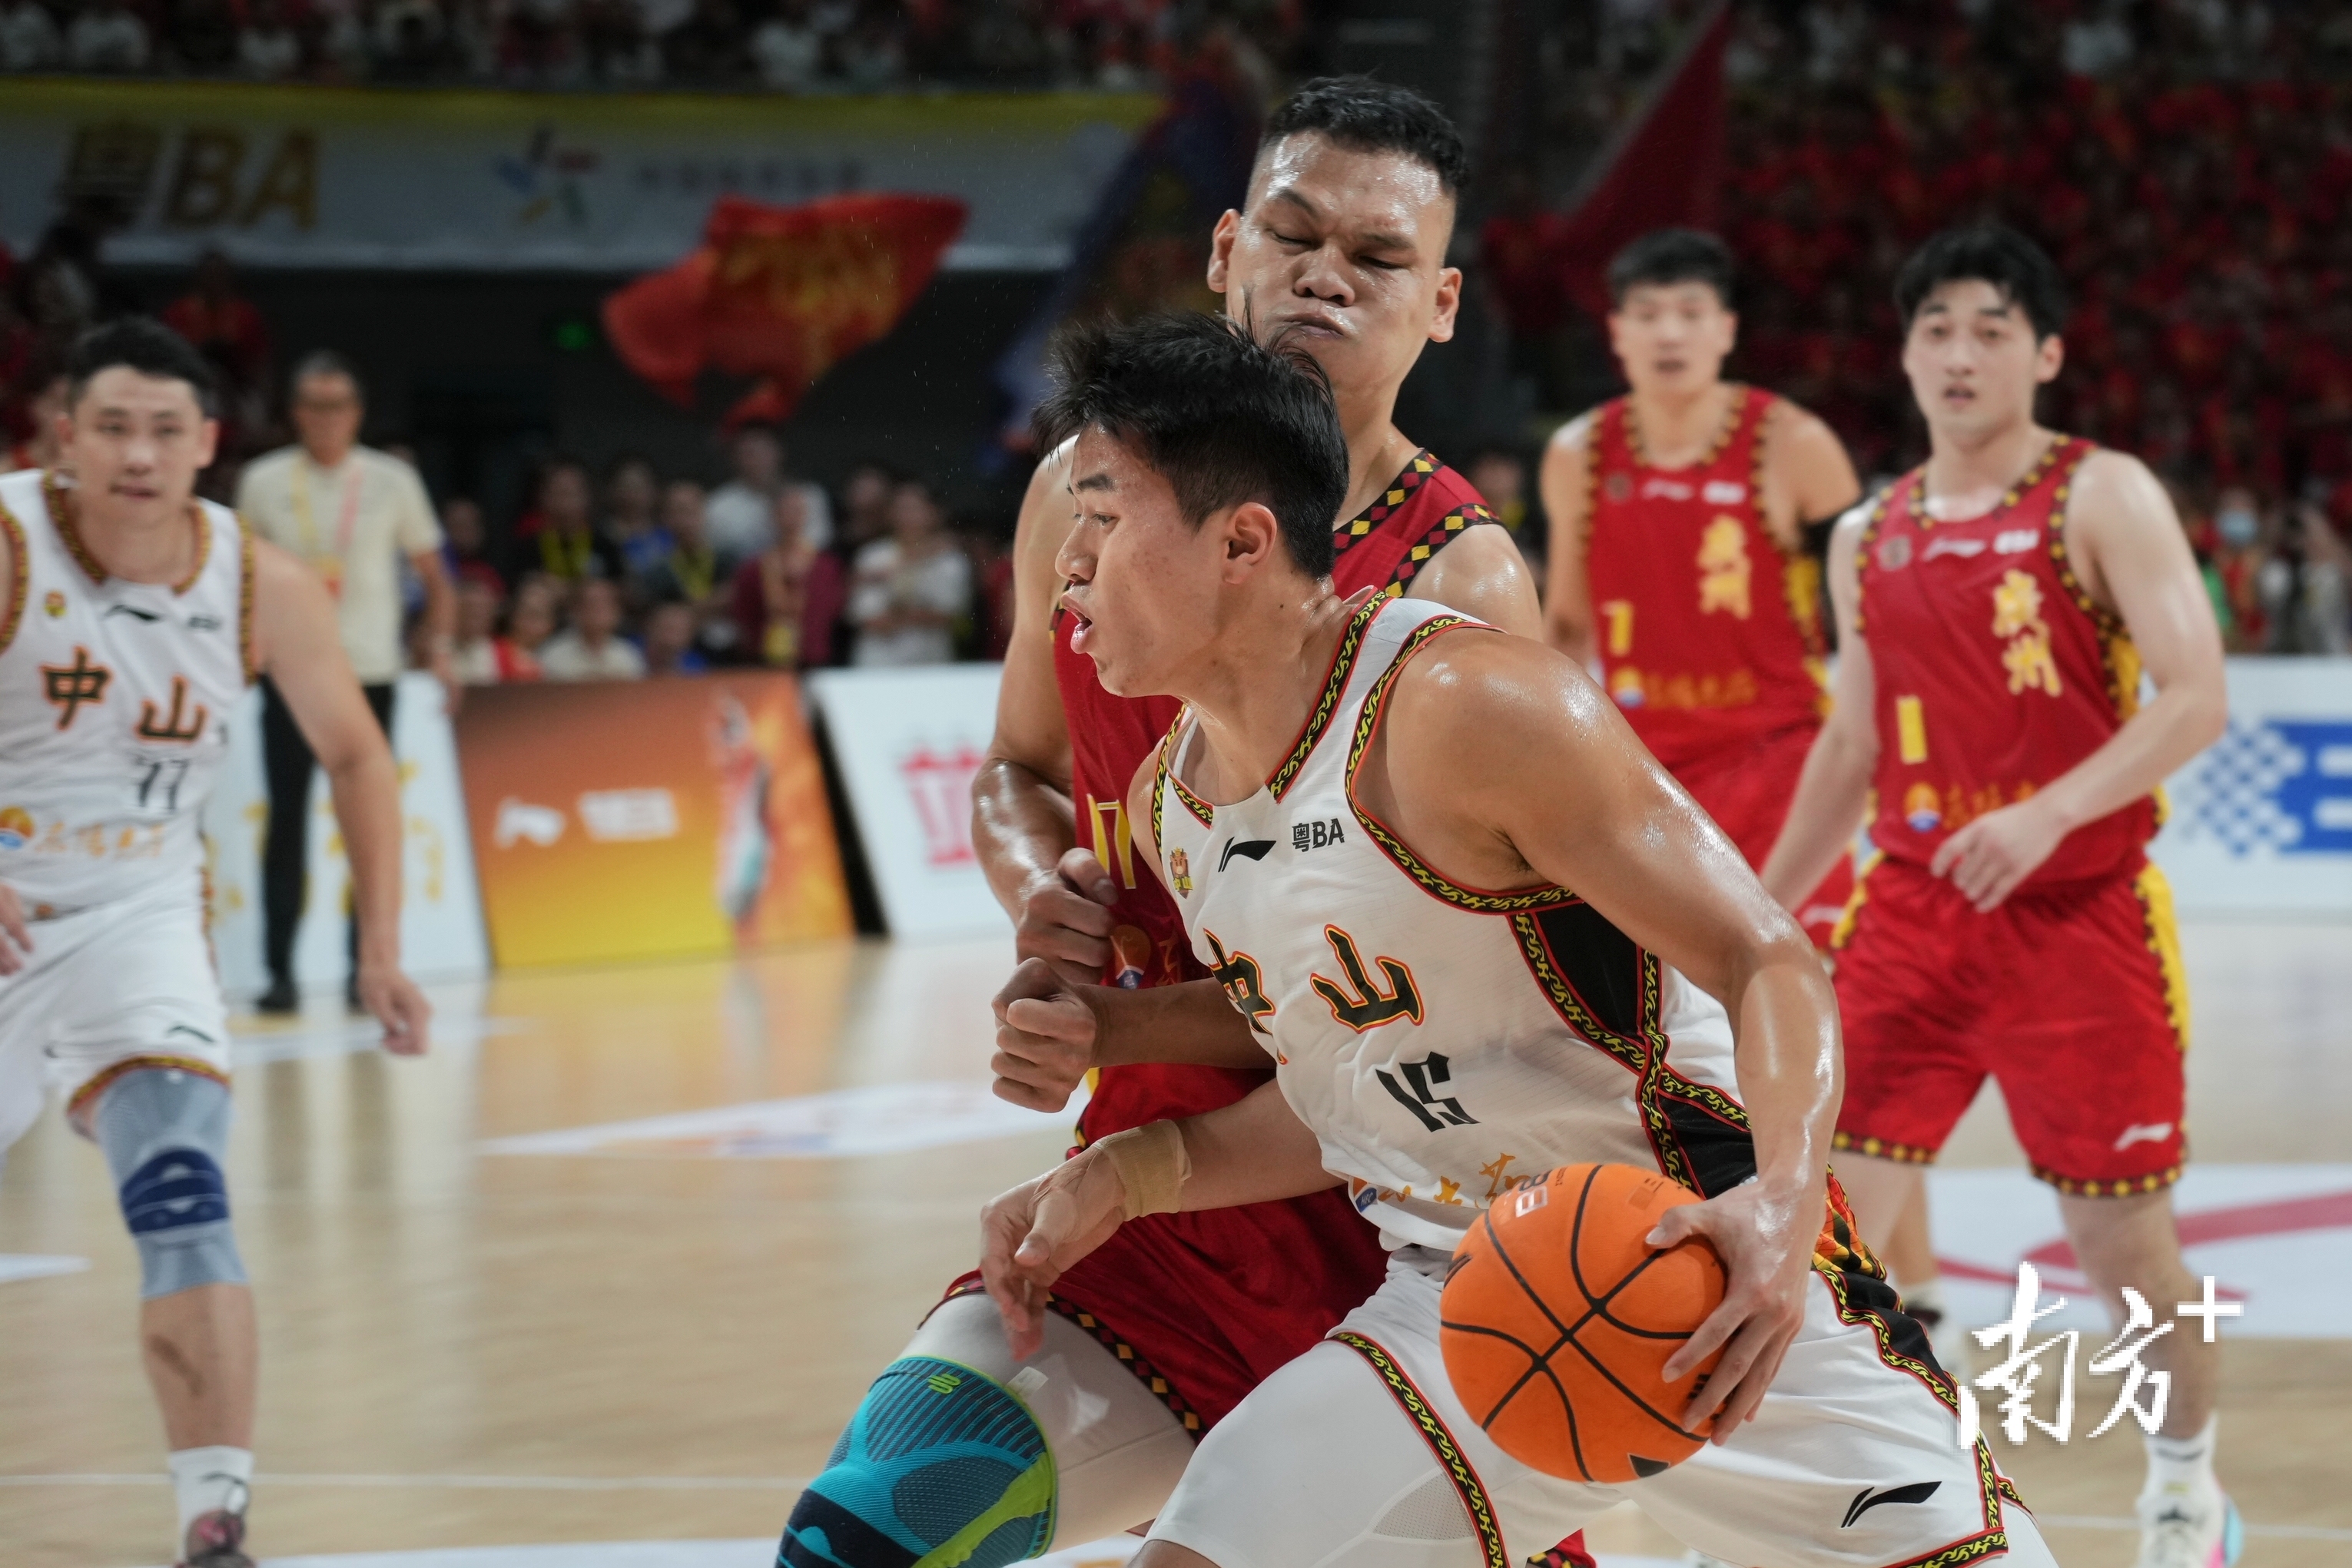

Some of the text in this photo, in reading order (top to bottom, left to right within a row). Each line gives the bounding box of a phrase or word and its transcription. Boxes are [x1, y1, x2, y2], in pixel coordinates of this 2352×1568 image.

[38, 644, 209, 748] 中山
[1086, 793, 1136, 890] 17
[1291, 817, 1345, 853] 粤BA
[1375, 1050, 1481, 1133] 15
